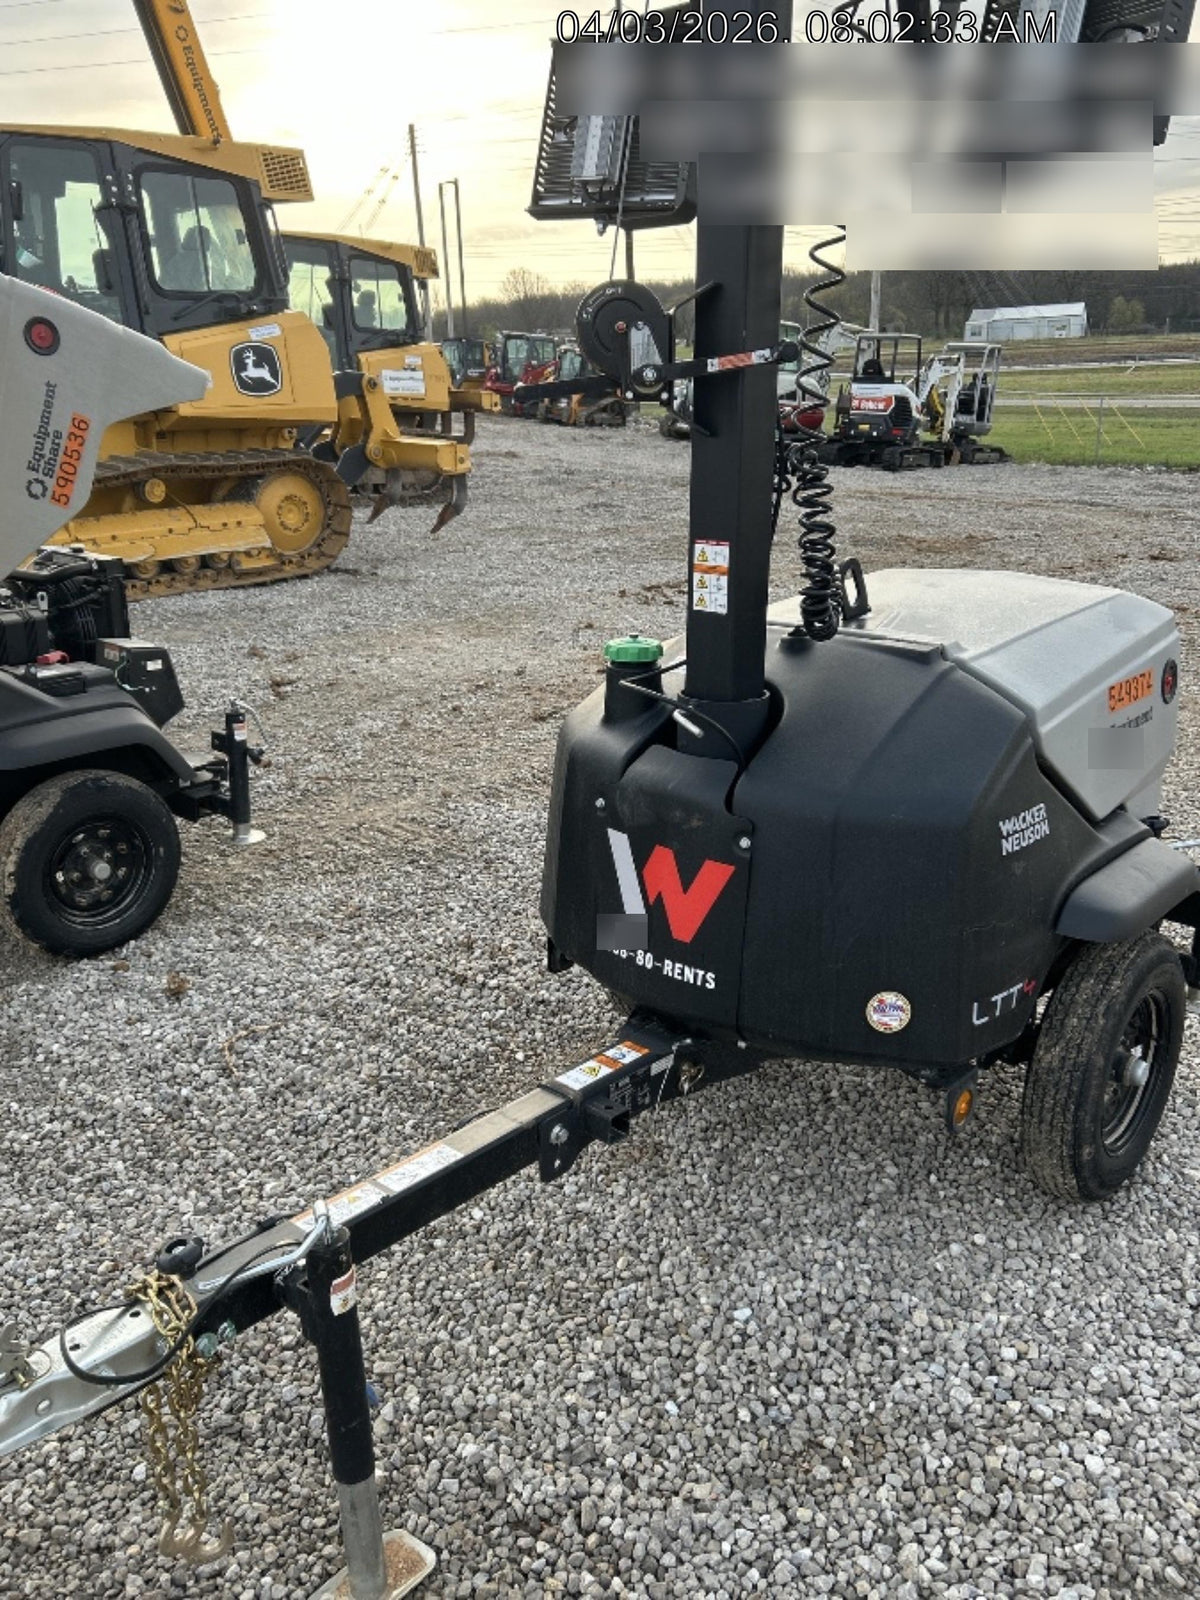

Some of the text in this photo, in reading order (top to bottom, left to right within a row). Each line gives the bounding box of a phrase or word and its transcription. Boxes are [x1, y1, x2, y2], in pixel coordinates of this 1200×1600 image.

[27, 380, 57, 473] Equipment
[42, 429, 62, 478] Share
[51, 416, 90, 506] 590536
[1108, 671, 1153, 712] 549374
[999, 803, 1047, 837] WACKER
[1001, 819, 1050, 856] NEUSON
[608, 950, 716, 989] -80-RENTS
[973, 978, 1037, 1027] LTT4
